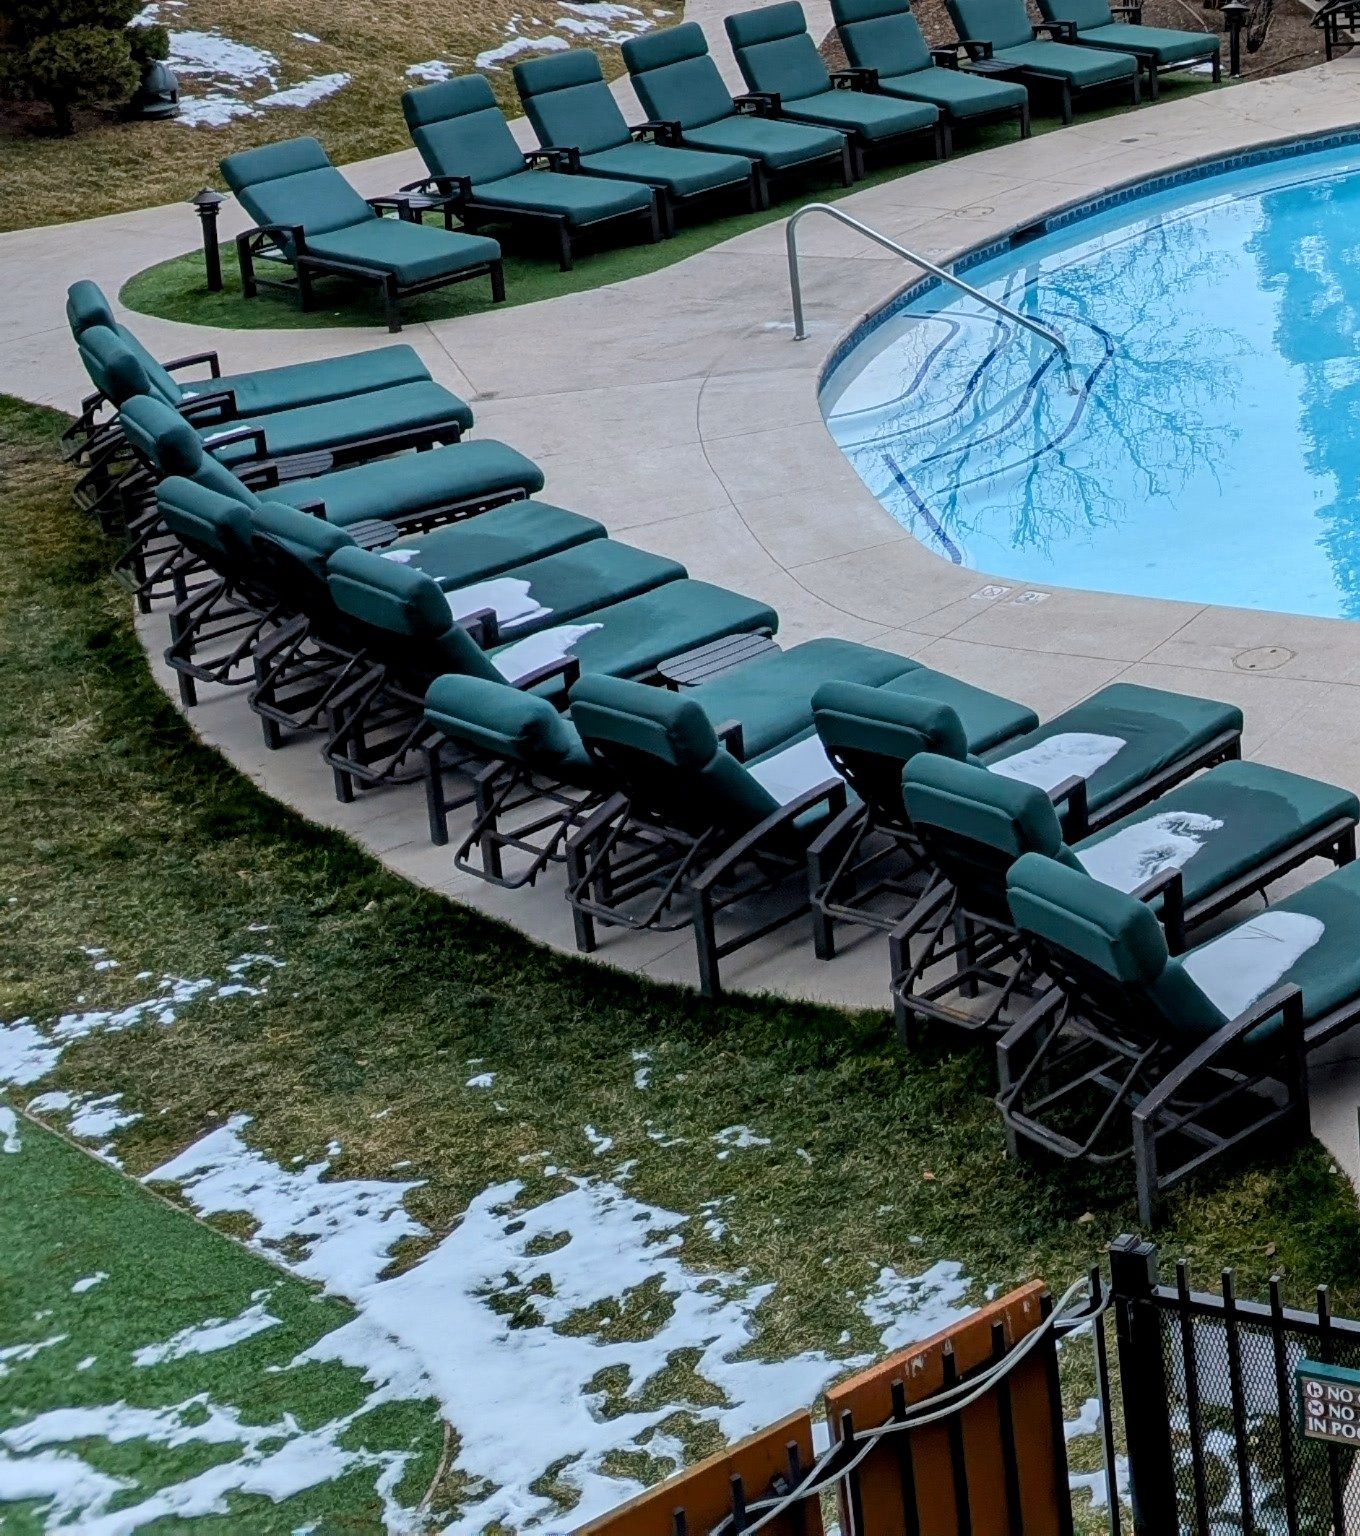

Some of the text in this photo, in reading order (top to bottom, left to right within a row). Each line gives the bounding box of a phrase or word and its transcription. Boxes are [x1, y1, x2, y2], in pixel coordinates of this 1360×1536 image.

[1327, 1386, 1353, 1403] NO
[1328, 1403, 1354, 1421] NO
[1308, 1416, 1327, 1434] IN
